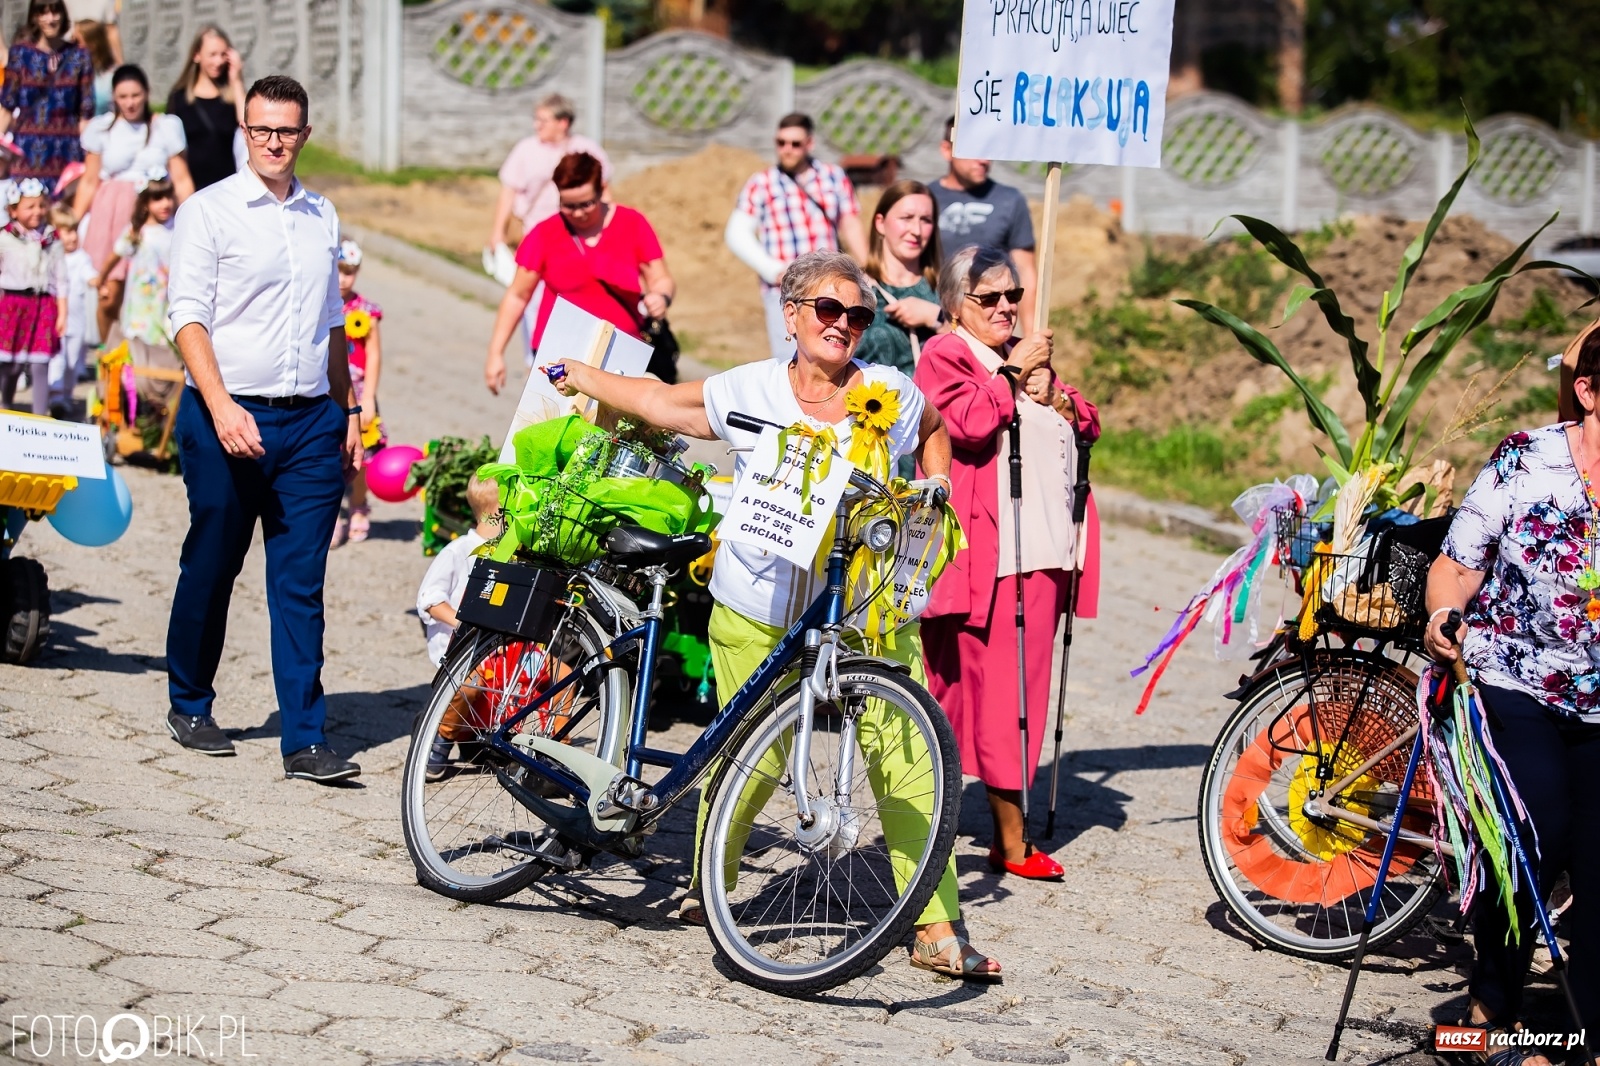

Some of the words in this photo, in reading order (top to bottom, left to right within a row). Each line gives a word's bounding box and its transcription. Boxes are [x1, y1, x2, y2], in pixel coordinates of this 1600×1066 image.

[1098, 0, 1140, 42] WIĘC
[1012, 71, 1150, 148] RELAKSUJĄ
[8, 424, 47, 436] Fojcika
[53, 431, 89, 442] szybko
[752, 472, 792, 490] RENTY
[793, 486, 826, 506] MŁO
[740, 496, 749, 504] A
[752, 498, 816, 529] POSZALEĆ
[752, 512, 770, 523] BY
[772, 519, 793, 535] SIĘ
[740, 523, 794, 548] CHCIAŁO
[847, 675, 879, 683] KENDA
